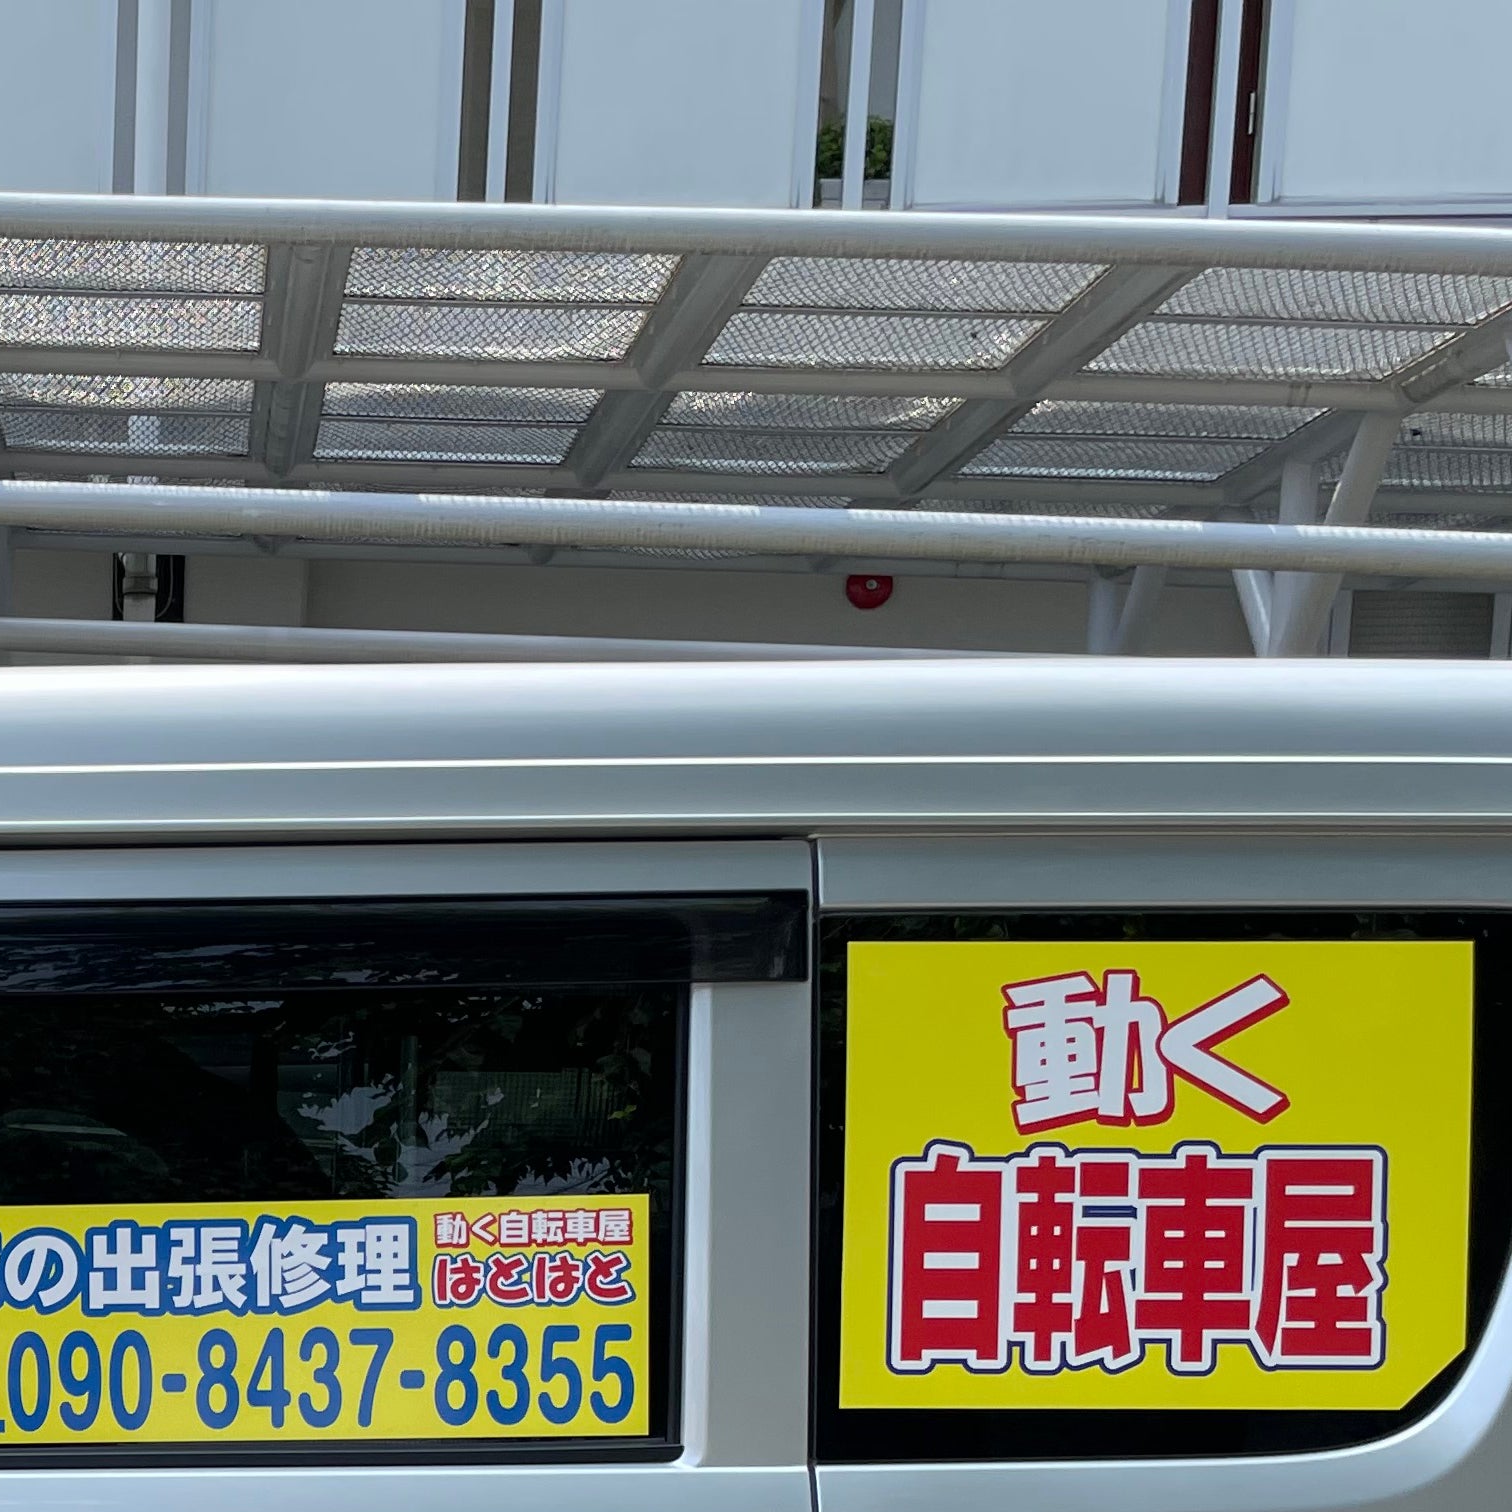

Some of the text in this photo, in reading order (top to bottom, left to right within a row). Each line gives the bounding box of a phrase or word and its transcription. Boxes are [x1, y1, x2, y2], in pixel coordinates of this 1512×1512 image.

[1002, 969, 1290, 1135] 動く
[434, 1208, 633, 1248] 動く自転車屋
[434, 1251, 633, 1307] はとはと
[892, 1143, 1384, 1371] 自転車屋
[7, 1322, 635, 1432] 090-8437-8355
